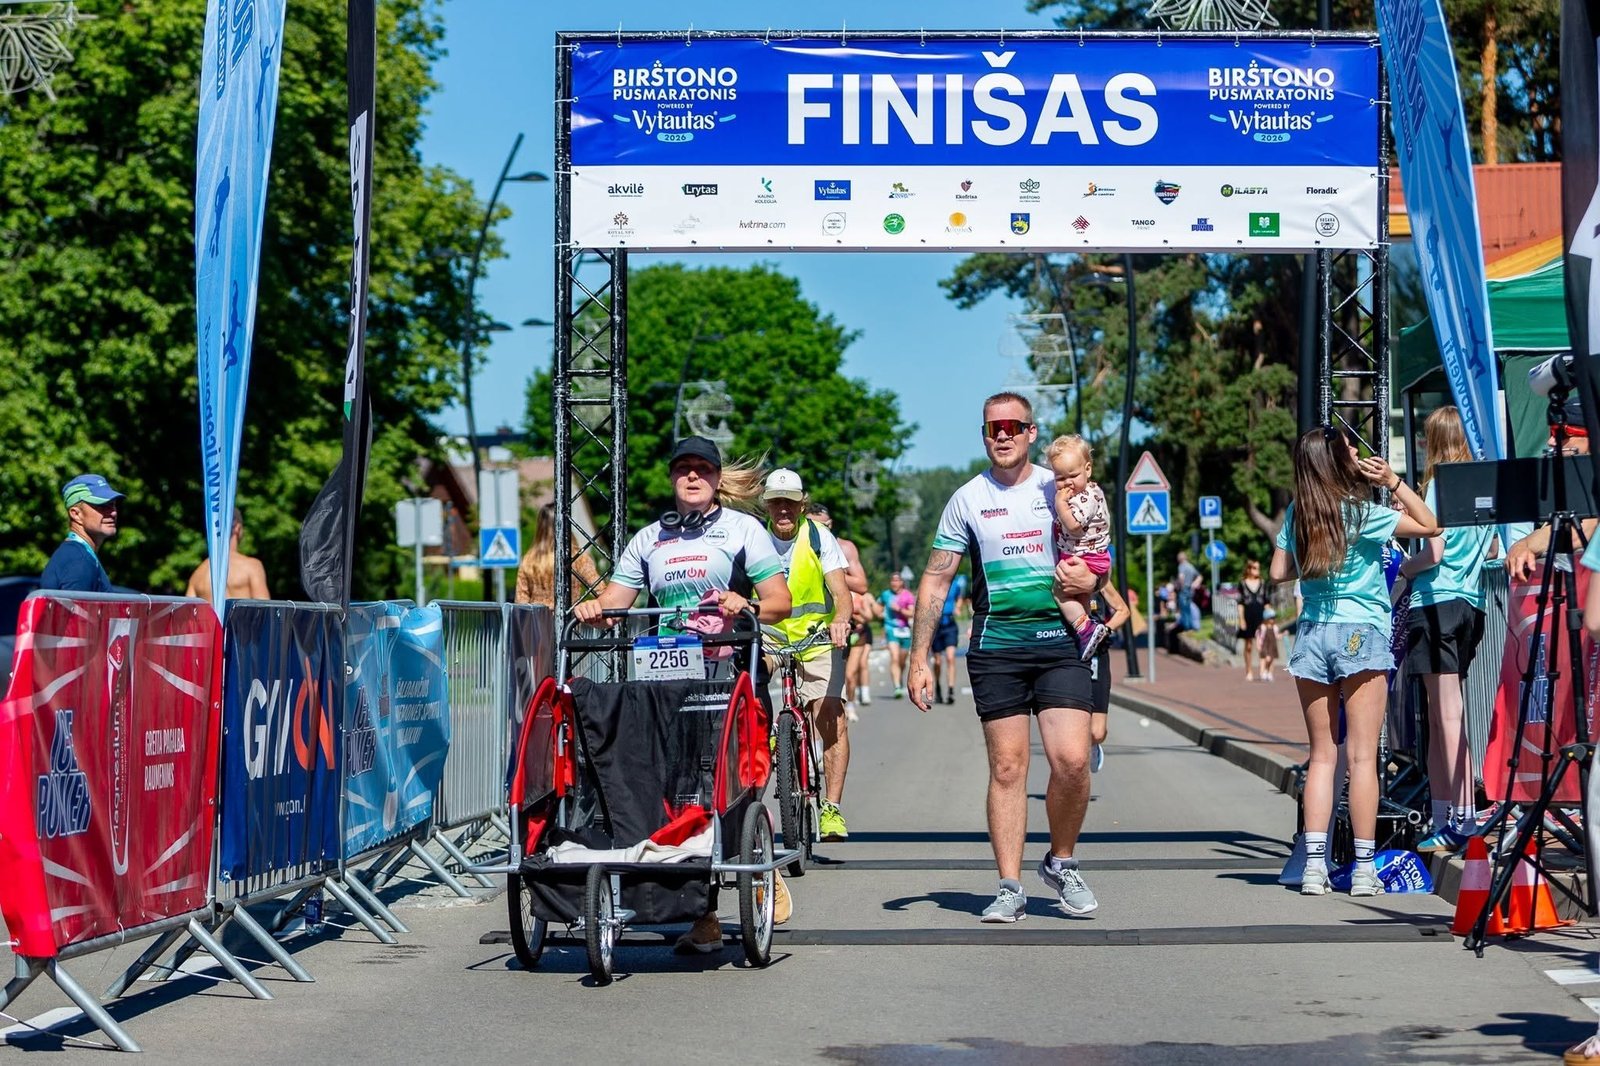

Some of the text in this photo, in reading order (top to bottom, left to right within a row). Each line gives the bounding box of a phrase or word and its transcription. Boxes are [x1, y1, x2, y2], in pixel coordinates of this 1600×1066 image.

[613, 60, 738, 87] BIRŠTONO
[1208, 60, 1335, 87] BIRŠTONO
[613, 88, 737, 101] PUSMARATONIS
[787, 51, 1159, 146] FINIŠAS
[1209, 88, 1335, 101] PUSMARATONIS
[632, 109, 716, 135] Vytautas
[1228, 109, 1313, 135] Vytautas
[607, 183, 645, 194] akvilė
[685, 184, 717, 197] Lrytas
[818, 186, 847, 196] Vytautas
[1305, 186, 1338, 195] Floradix
[1205, 498, 1217, 515] P
[1002, 543, 1044, 556] GYMON
[664, 567, 707, 582] GYMON
[1035, 628, 1068, 639] SONAX
[648, 649, 689, 670] 2256
[49, 708, 79, 774] ICE
[110, 704, 124, 847] Magnesium
[36, 771, 93, 840] POWER
